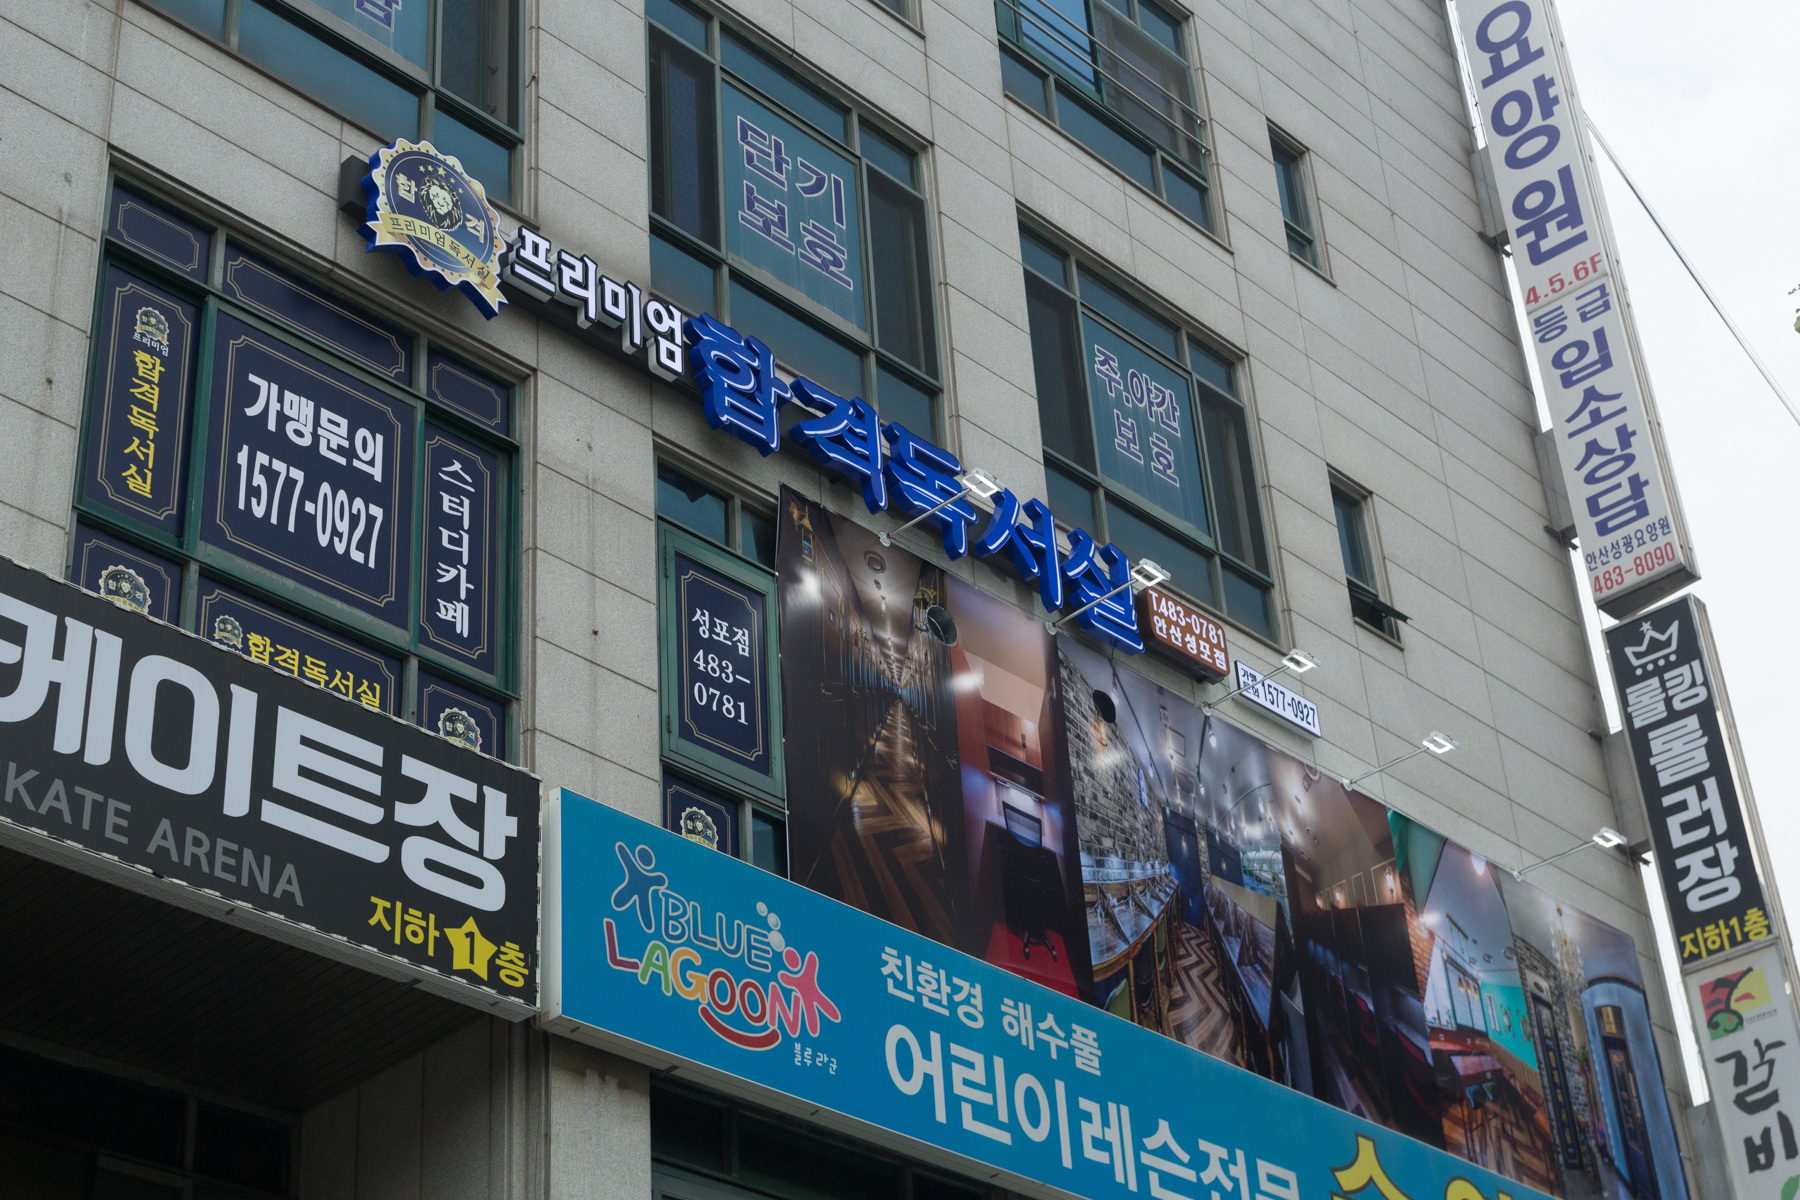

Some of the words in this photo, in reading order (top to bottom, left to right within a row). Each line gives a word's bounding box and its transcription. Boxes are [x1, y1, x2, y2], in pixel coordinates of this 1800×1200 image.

[737, 115, 846, 229] 단기
[1475, 0, 1589, 267] 요양원
[738, 179, 853, 291] 보호
[1526, 252, 1603, 306] 4.5.6F
[1533, 282, 1612, 344] 등급
[133, 331, 170, 357] 프리미엄
[121, 349, 166, 499] 합격독서실
[244, 373, 384, 483] 가맹문의
[510, 224, 685, 376] 프리미엄
[683, 312, 1145, 655] 합격독서실
[1114, 408, 1180, 488] 보호
[1551, 326, 1650, 537] 입소상담
[237, 444, 384, 570] 1577-0927
[435, 459, 476, 639] 스터디카페
[1585, 516, 1672, 573] 안산성광요양원
[1593, 541, 1676, 594] 483-8090
[691, 607, 750, 657] 성포점
[1148, 589, 1226, 649] T.483-0781
[1153, 615, 1228, 672] 안산성포점
[247, 632, 381, 711] 합격독서실
[694, 682, 748, 725] 0781
[1261, 680, 1317, 730] 1577-0927
[1648, 713, 1741, 913] 롤러장
[146, 817, 305, 907] ARENA
[659, 888, 774, 973] BLUE
[1679, 906, 1769, 959] 지하1층
[603, 917, 801, 1039] LAGOON
[880, 945, 985, 1030] 친환경
[1000, 997, 1103, 1077] 해수풀
